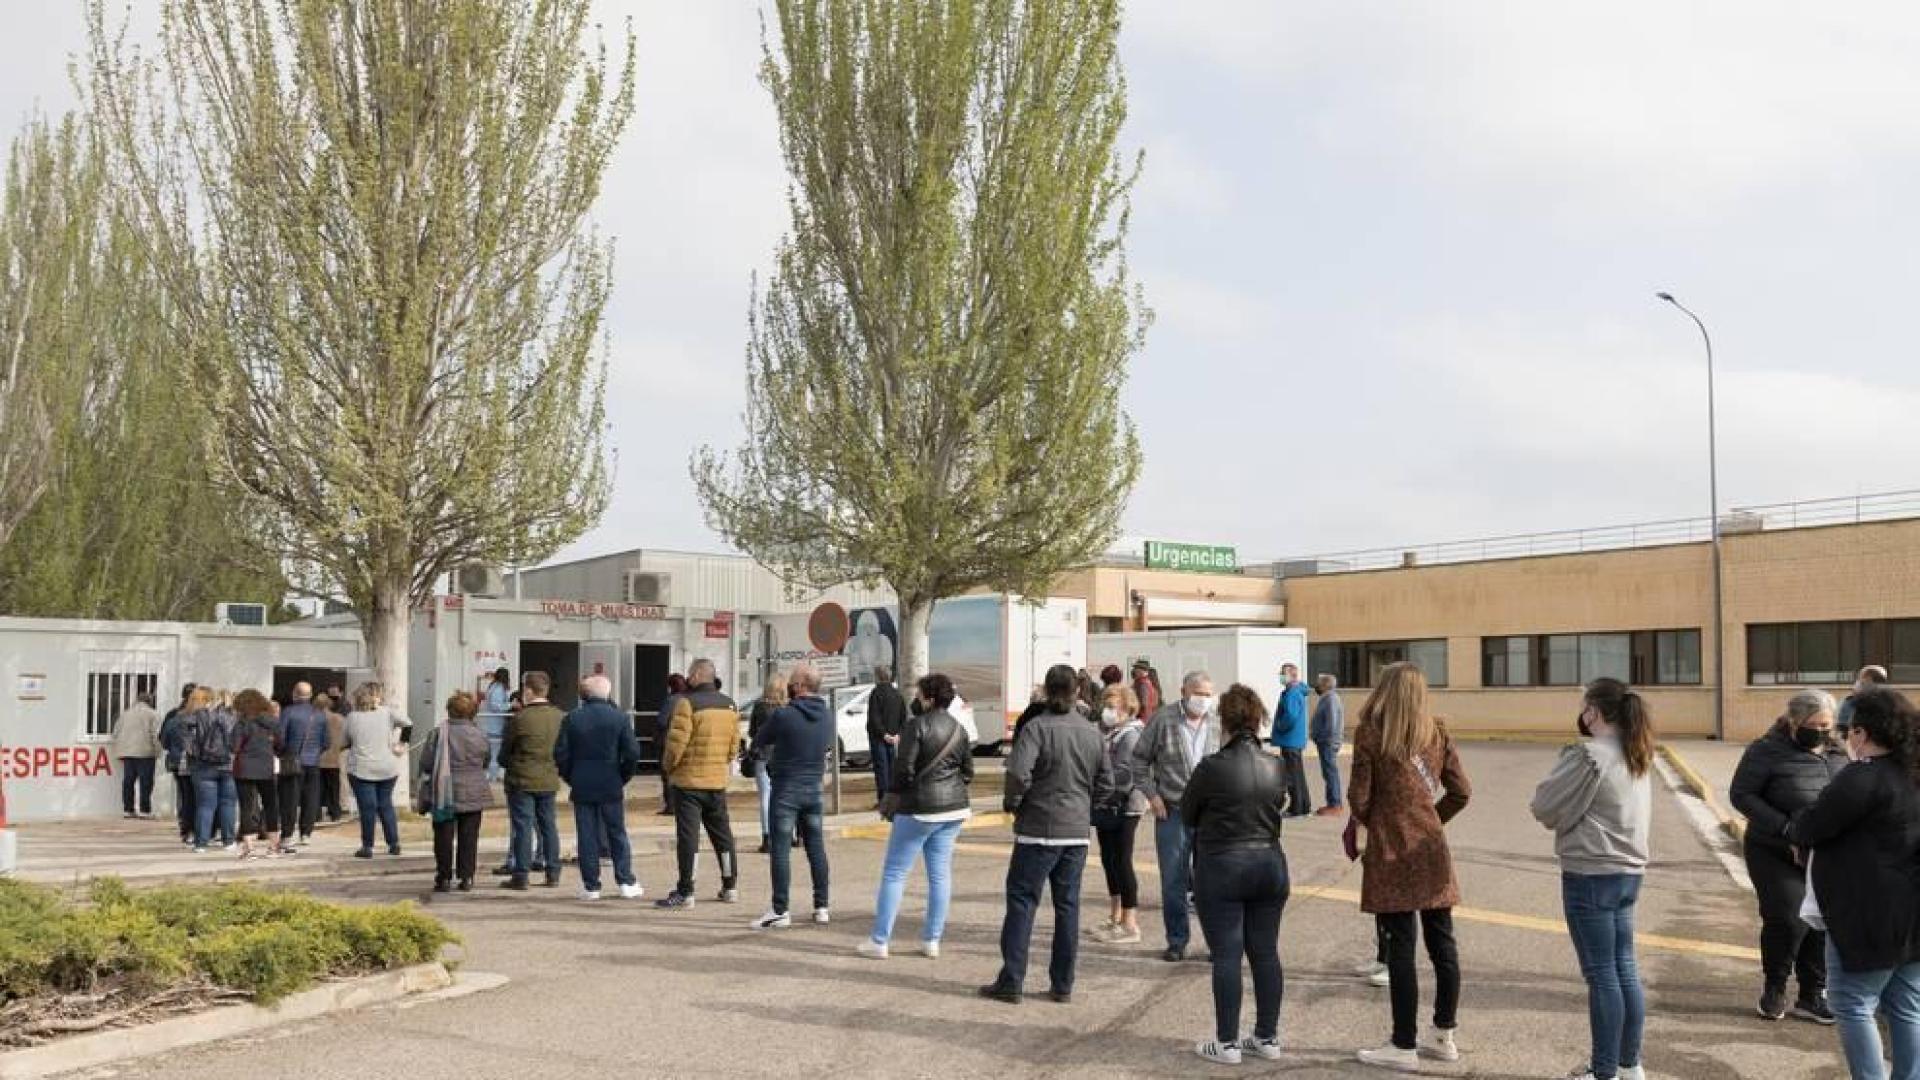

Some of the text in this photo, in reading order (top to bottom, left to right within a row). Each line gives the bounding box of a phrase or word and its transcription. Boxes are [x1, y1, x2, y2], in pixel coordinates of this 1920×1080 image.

[1149, 542, 1234, 569] Urgencias
[541, 602, 666, 620] TOMA DE MUESTRAS
